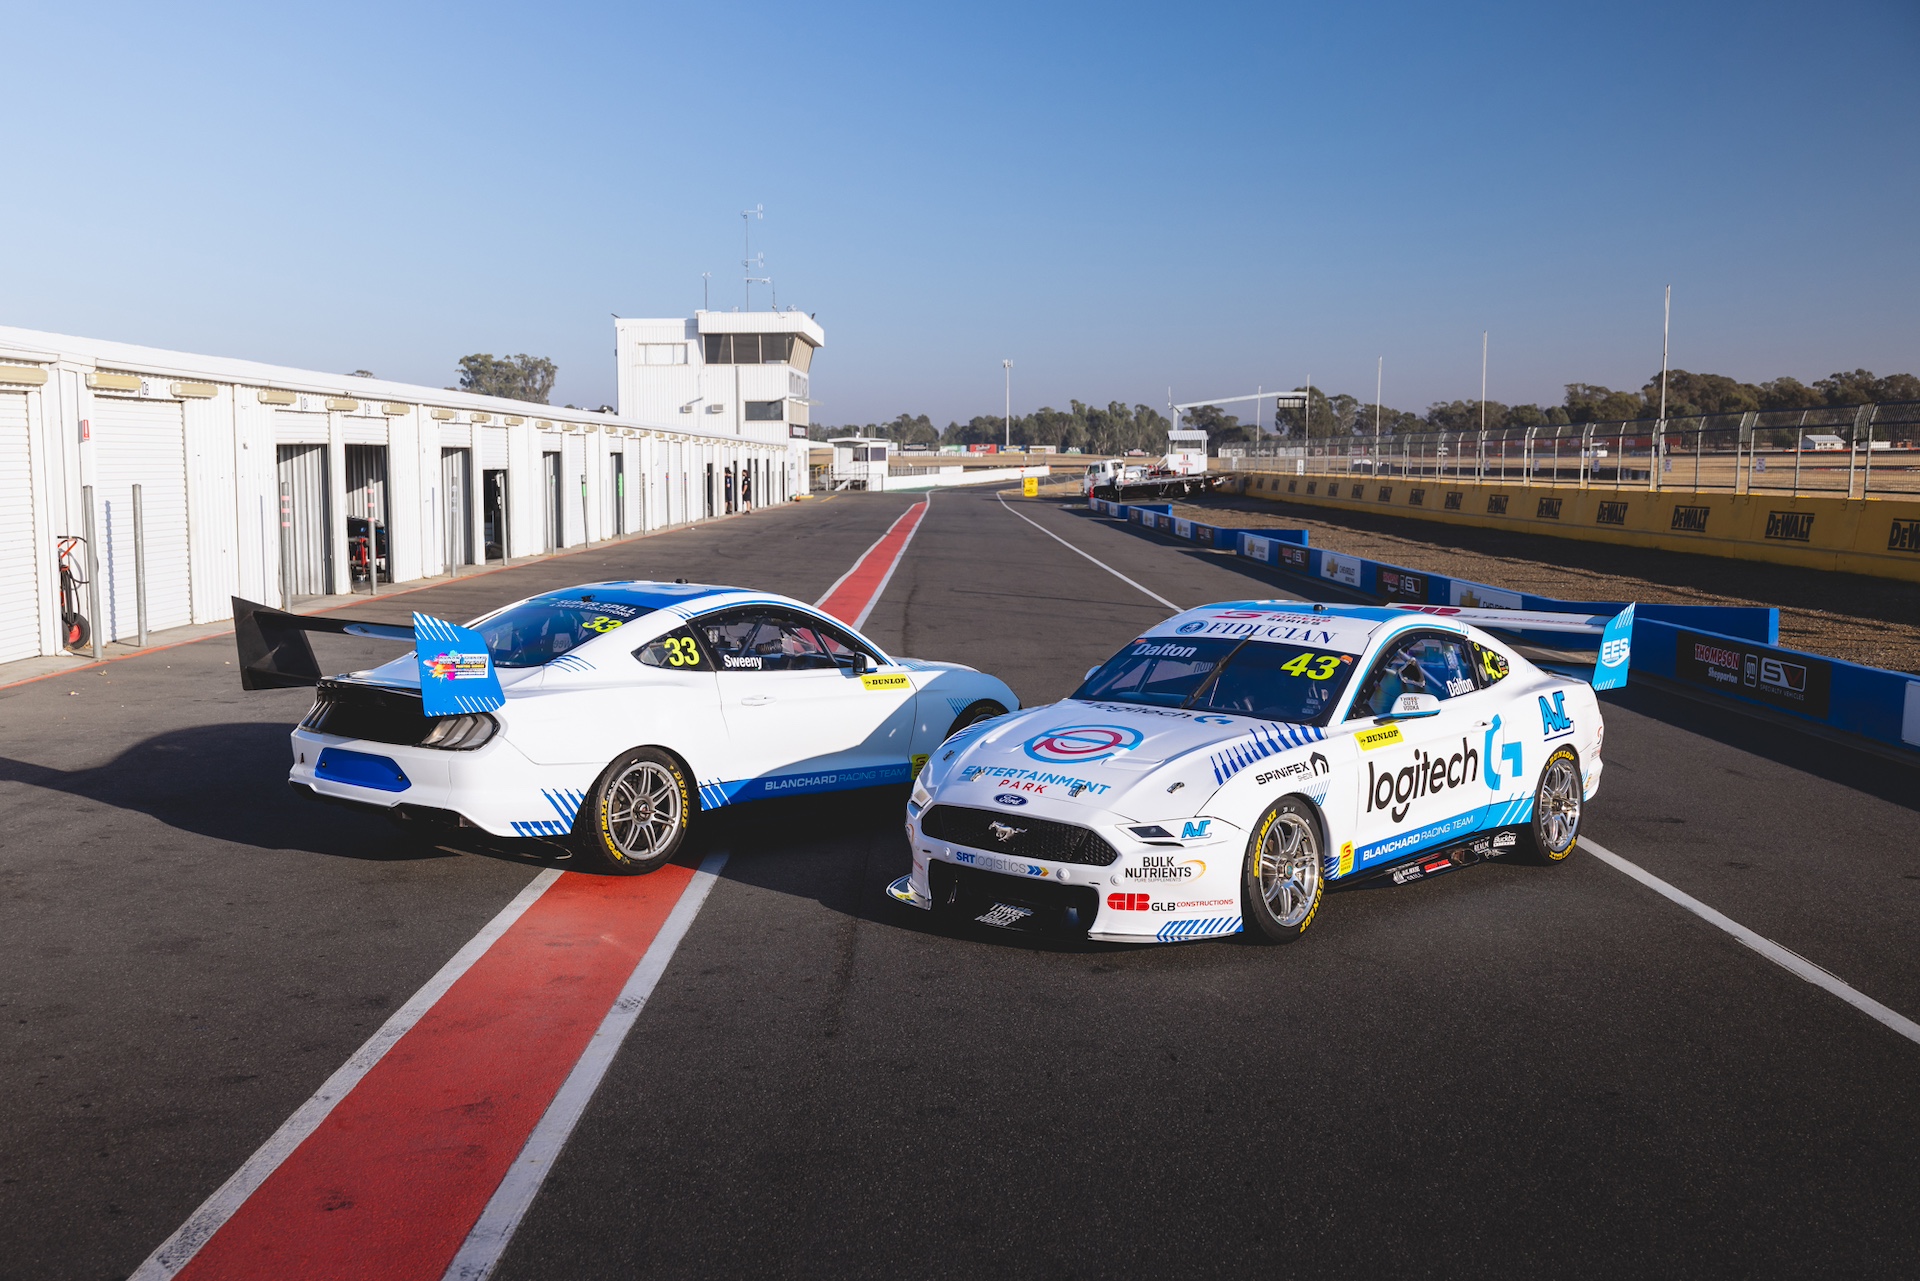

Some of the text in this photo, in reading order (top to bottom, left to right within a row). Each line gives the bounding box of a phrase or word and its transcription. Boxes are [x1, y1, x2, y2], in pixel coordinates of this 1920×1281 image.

[1671, 507, 1709, 530] DEWALT
[1766, 513, 1814, 540] DEWALT
[600, 603, 636, 615] SPILL
[582, 616, 623, 633] 33
[1203, 621, 1339, 644] FIDUCIAN
[664, 636, 700, 667] 33
[1131, 642, 1198, 658] Dalton
[1602, 637, 1629, 660] EES
[1695, 643, 1740, 670] THOMPSON
[723, 654, 763, 670] Sweeny
[1281, 652, 1341, 680] 43
[872, 678, 906, 686] DUNLOP
[1708, 667, 1738, 684] Shepparton
[1446, 676, 1475, 697] Dalton
[1761, 684, 1804, 701] SPECIALTY VEHICLES
[1090, 702, 1193, 719] logitech
[1366, 729, 1399, 743] DUNLOP
[1549, 751, 1575, 766] DUNLOP
[765, 768, 906, 790] BLANCHARD RACING TEAM
[961, 765, 1111, 795] ENTERTAINMENT
[998, 779, 1048, 794] PARK
[1366, 737, 1478, 823] logitech
[673, 771, 689, 829] DUNLOP
[999, 793, 1022, 805] Ford
[1363, 833, 1421, 861] BLANCHARD
[1420, 823, 1451, 841] RACING
[1452, 815, 1475, 830] TEAM
[1142, 856, 1175, 868] BULK
[1125, 867, 1192, 878] NUTRIENTS
[1151, 899, 1234, 912] GLB CONSTRUCTIONS
[1300, 876, 1325, 933] DUNLOP
